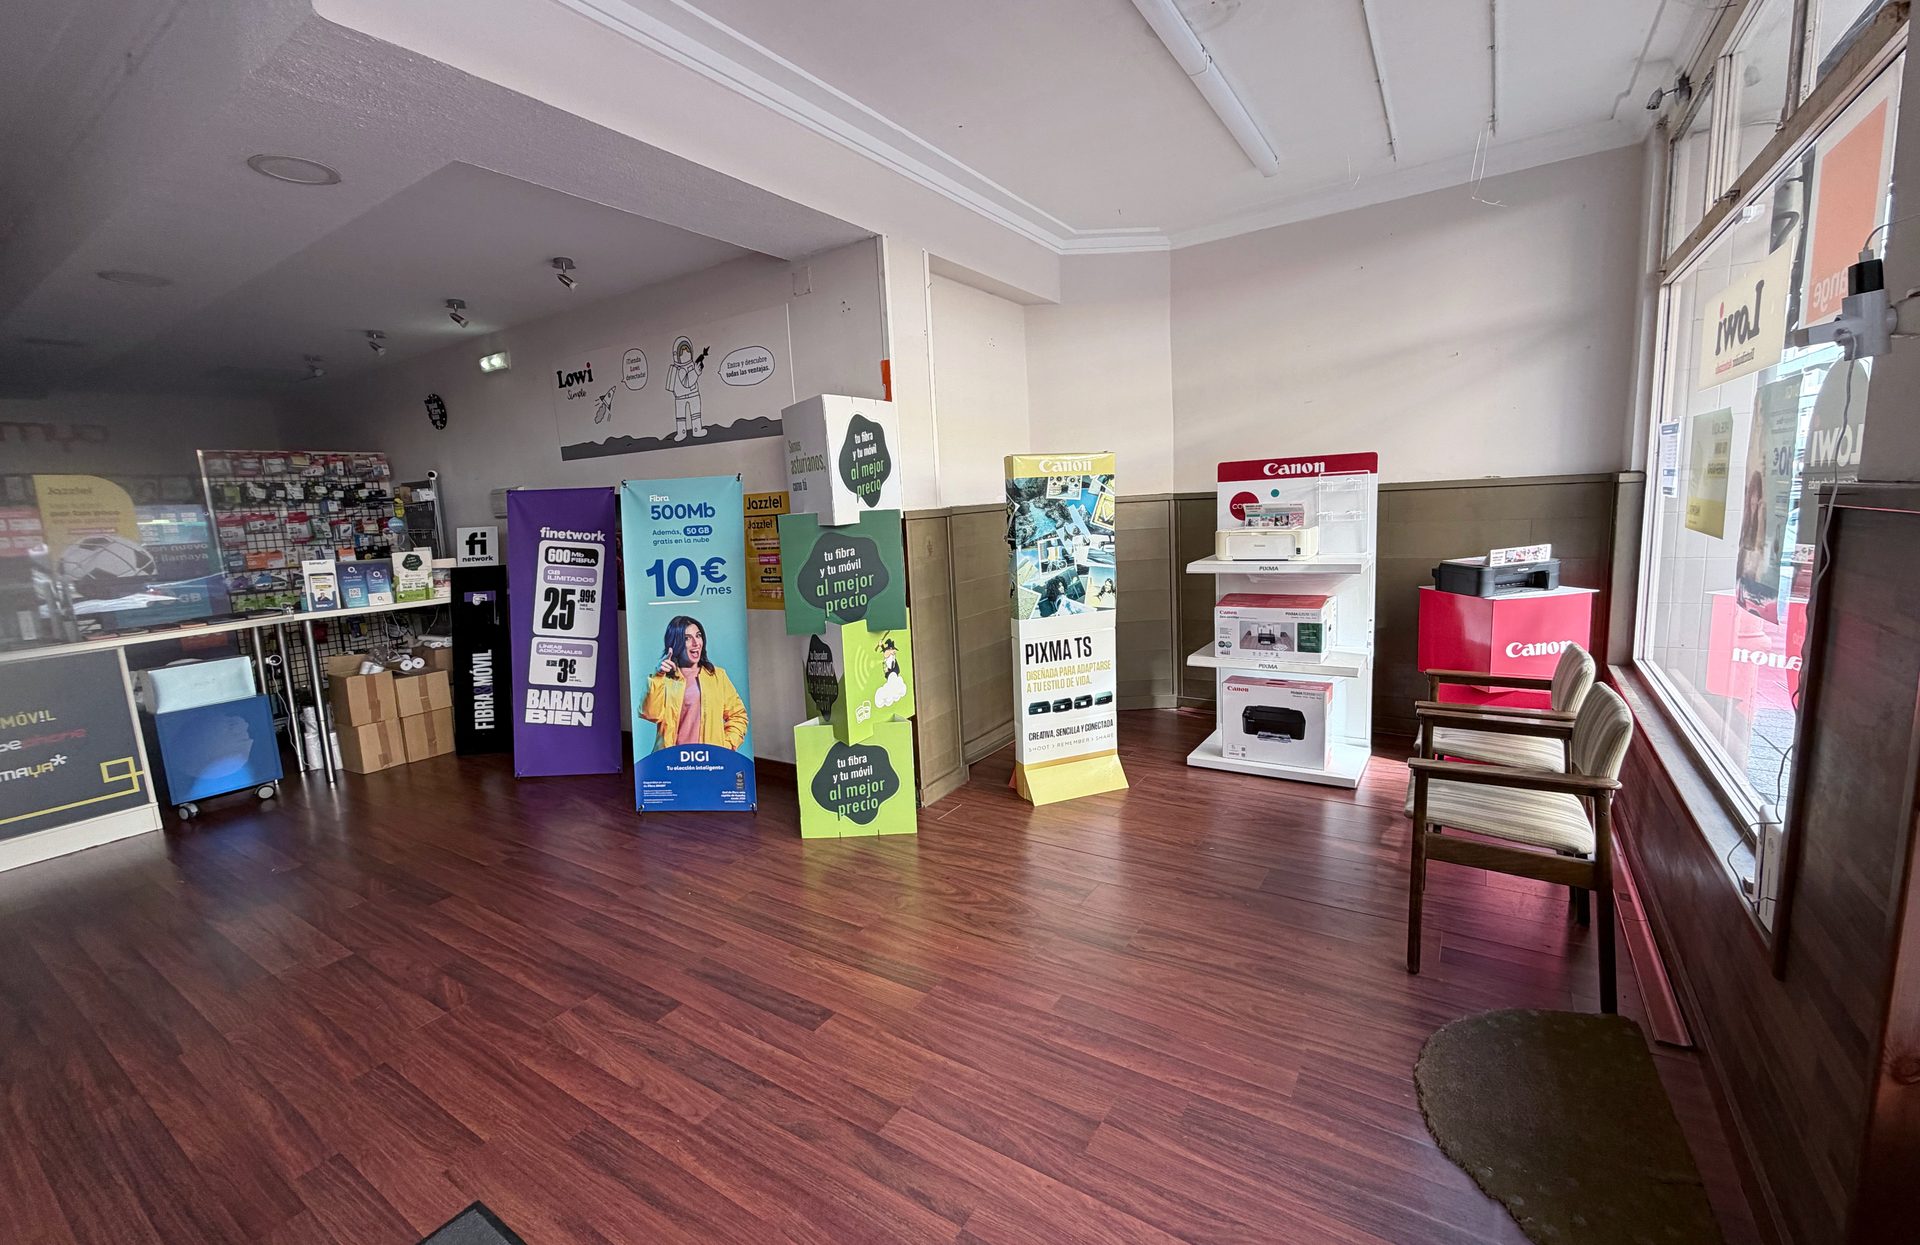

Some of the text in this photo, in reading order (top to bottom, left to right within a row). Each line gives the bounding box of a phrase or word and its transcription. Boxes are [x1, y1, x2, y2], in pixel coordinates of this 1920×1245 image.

[557, 362, 594, 389] Lowi
[567, 388, 587, 400] Simple
[854, 431, 873, 444] tu fibra
[852, 443, 877, 461] y tu móvil
[790, 453, 826, 475] asturianos,
[851, 459, 884, 480] al mejor
[1039, 460, 1092, 473] Canon
[1263, 461, 1326, 476] Canon
[857, 479, 881, 503] precio
[651, 502, 716, 520] 500Mb
[747, 495, 782, 510] Jazztel
[748, 520, 773, 529] Jazztel
[540, 527, 605, 542] finetwork
[653, 538, 673, 546] gratis
[465, 532, 487, 556] fi
[547, 548, 571, 563] 600
[824, 547, 856, 561] tu fibra
[820, 558, 862, 578] y tu móvil
[547, 575, 595, 583] ILIMITADOS
[816, 574, 874, 597] al mejor
[700, 585, 732, 596] /mes
[825, 593, 868, 617] precio
[1025, 636, 1092, 665] PIXMA TS
[1026, 660, 1111, 681] DISEÑADA PARA ADAPTARSE
[1026, 676, 1093, 693] A TU ESTILO DE VIDA.
[526, 689, 594, 713] BARATO
[525, 708, 593, 727] BIEN
[1028, 719, 1113, 741] CREATIVA, SENCILLA Y CONECTADA
[1028, 744, 1050, 752] SHOOT
[1057, 737, 1089, 749] REMEMBER
[680, 751, 709, 762] DIGI
[837, 754, 868, 768] tu fibra
[833, 765, 873, 783] y tu móvil
[829, 779, 885, 801] al mejor
[838, 797, 879, 820] precio
